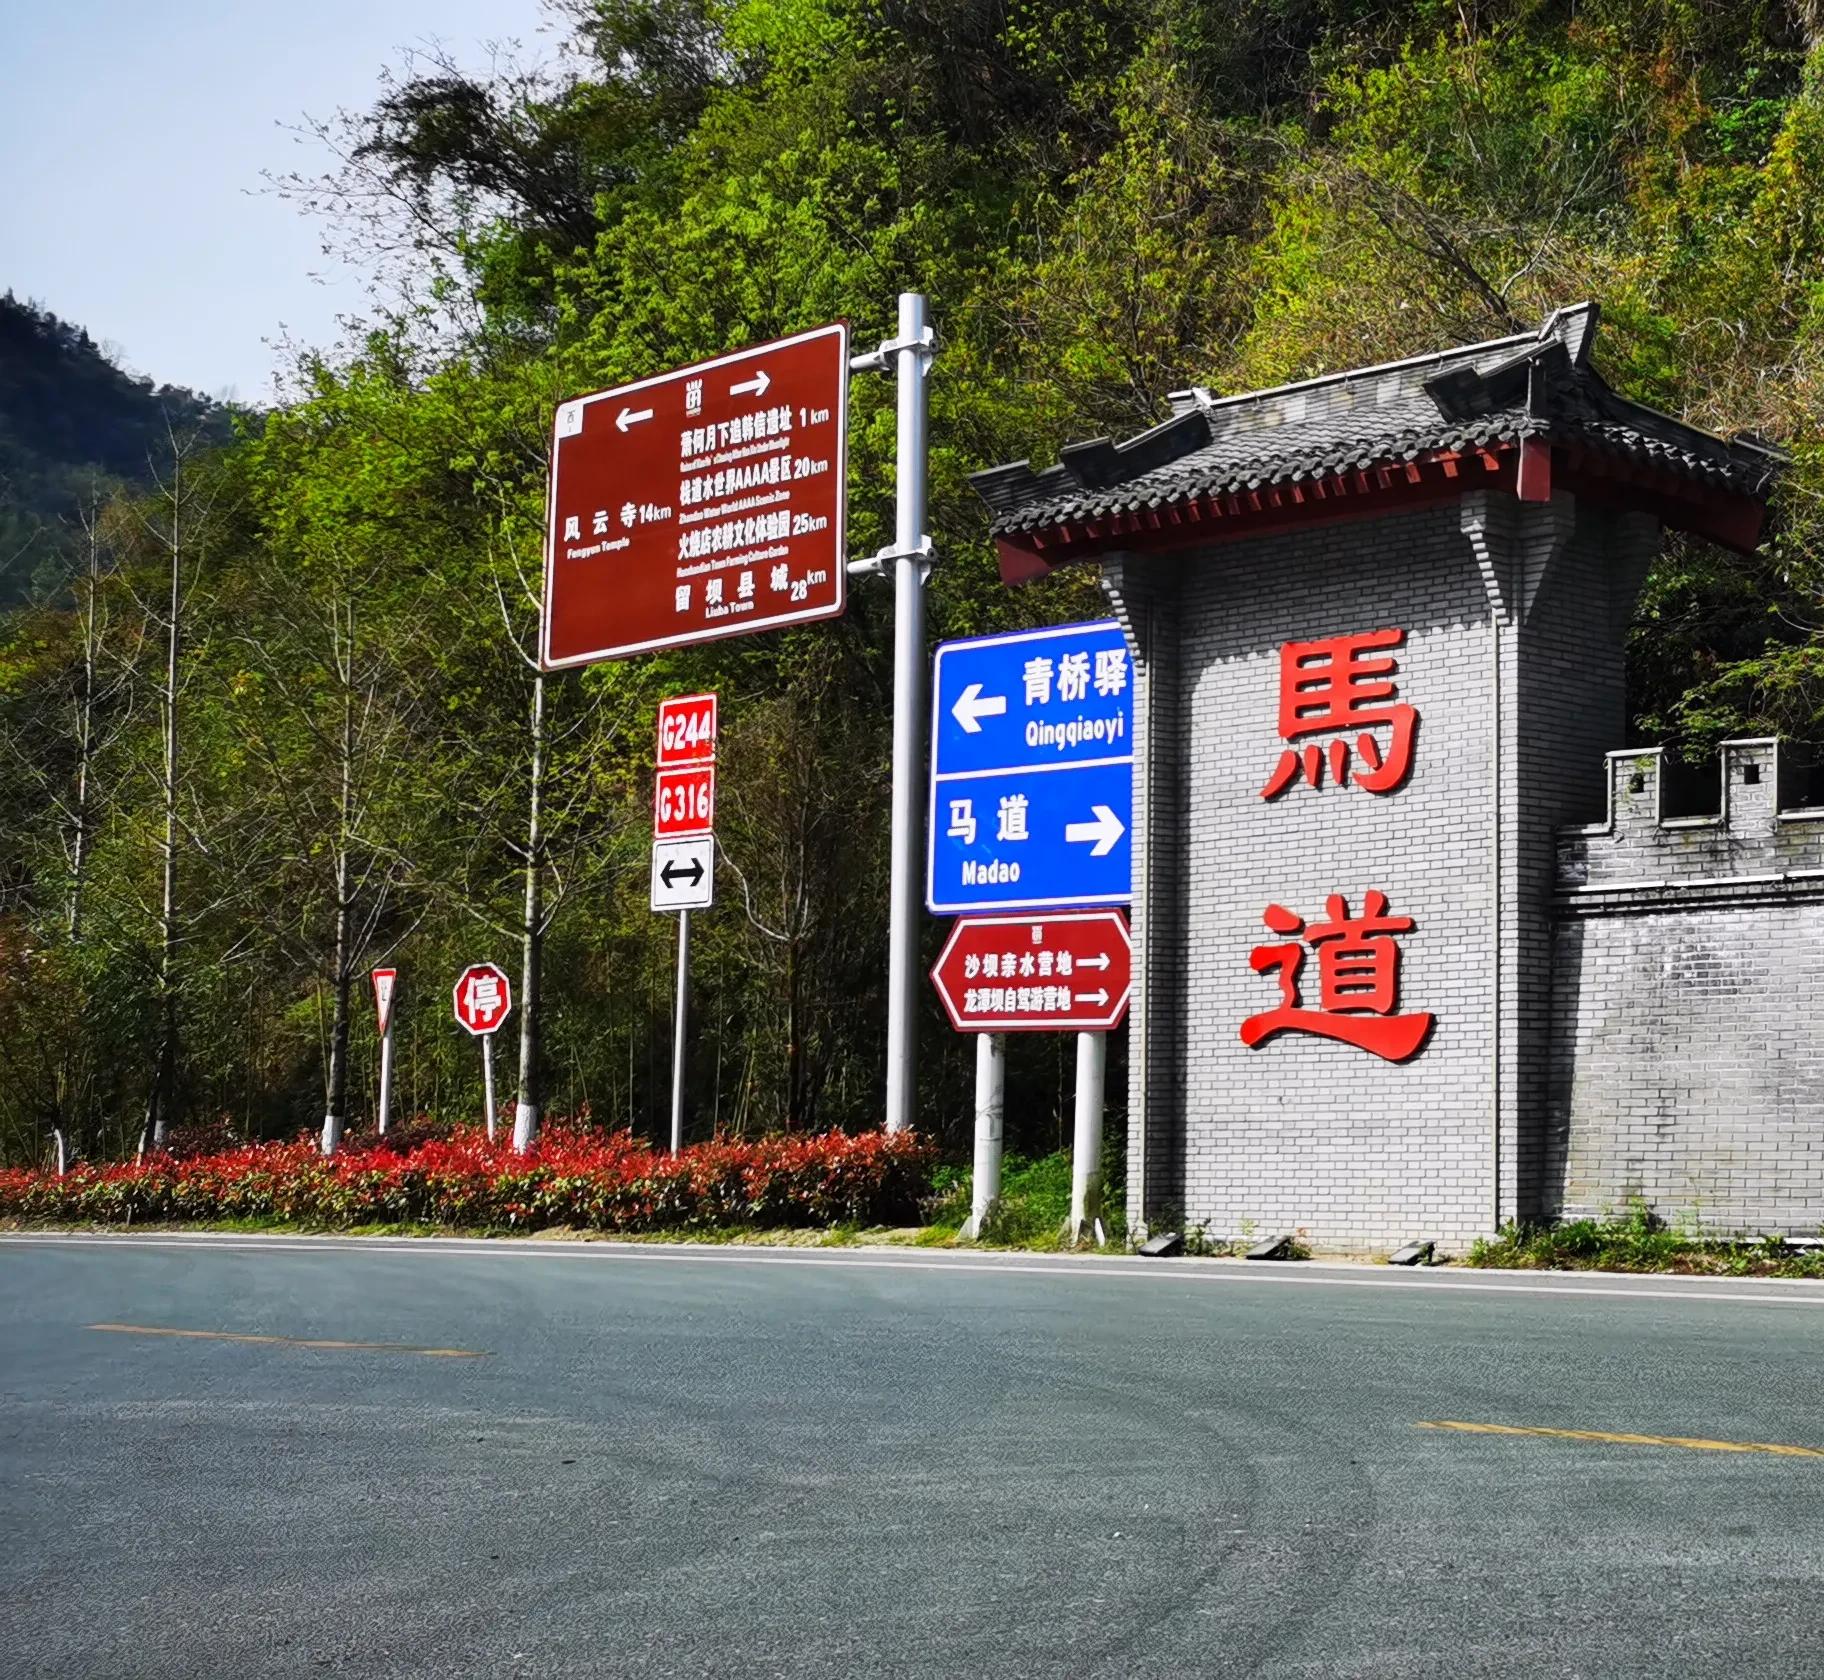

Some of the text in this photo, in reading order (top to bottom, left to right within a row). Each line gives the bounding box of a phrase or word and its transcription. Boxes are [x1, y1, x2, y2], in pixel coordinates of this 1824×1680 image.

[799, 408, 807, 427] 1
[811, 409, 829, 425] km
[680, 455, 828, 506] 栈道水世界AAAA景区 20km
[564, 502, 671, 542] 风云寺 14km
[678, 510, 827, 560] 火烧店农耕文化体验园 25km
[601, 537, 630, 552] Temple
[675, 563, 789, 613] 留坝县城
[730, 601, 754, 614] Town
[1023, 648, 1129, 706] 青桥驿
[662, 709, 711, 752] G244
[1025, 711, 1124, 751] Qingqiaoyi
[660, 785, 709, 823] G316
[947, 793, 1029, 845] 马道
[1239, 629, 1432, 1061] 馬道
[962, 859, 1020, 886] Madao
[964, 950, 1073, 979] 沙坝亲水营地
[463, 975, 502, 1025] 停
[963, 985, 1072, 1013] 龙潭坝自驾游营地
